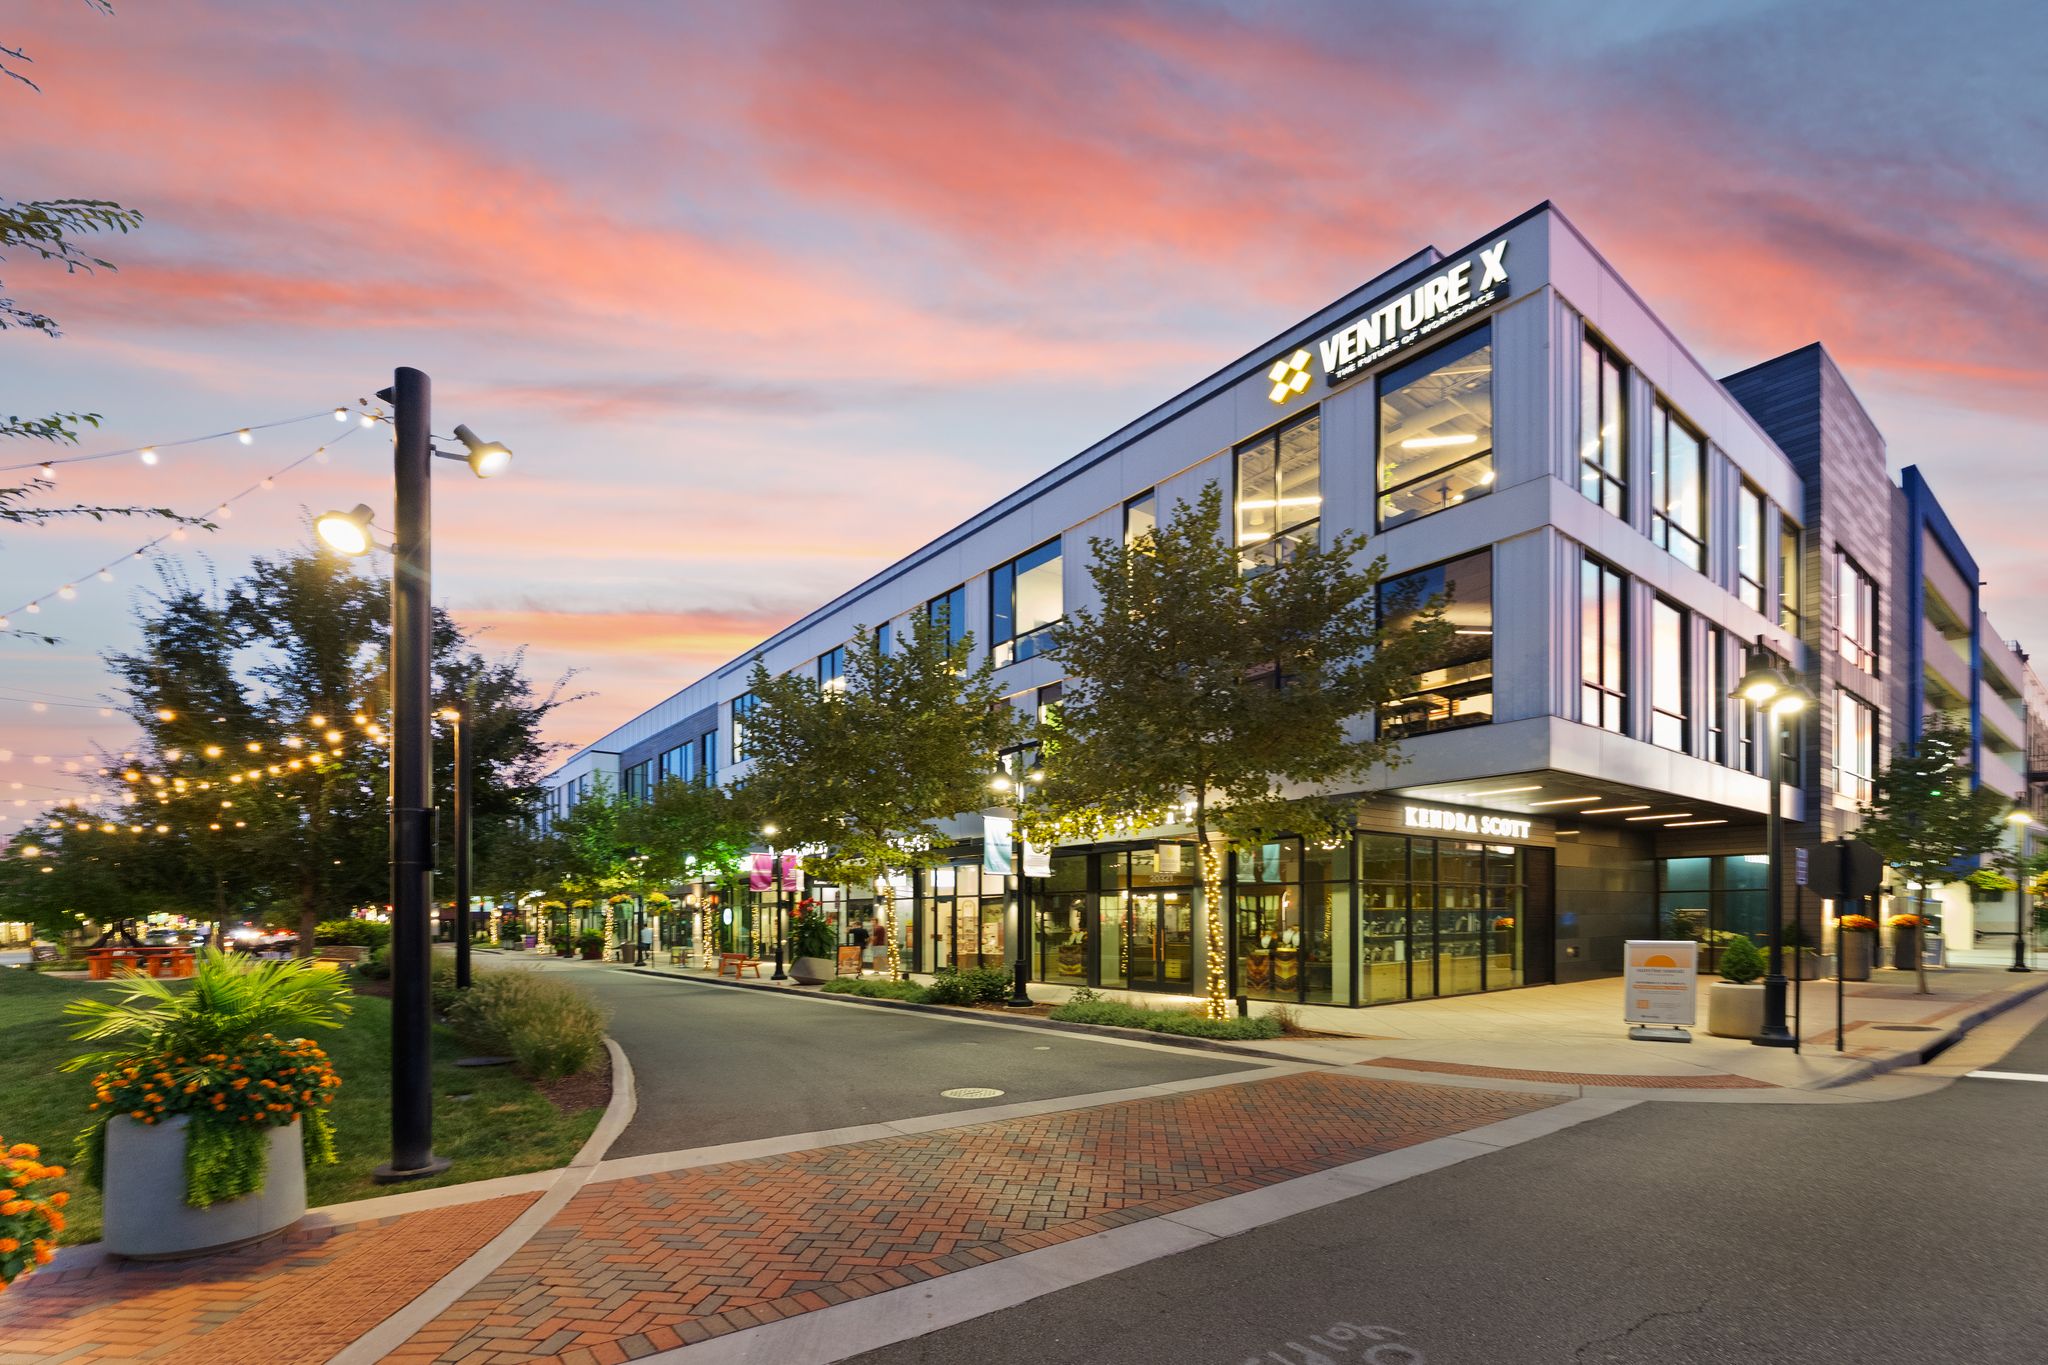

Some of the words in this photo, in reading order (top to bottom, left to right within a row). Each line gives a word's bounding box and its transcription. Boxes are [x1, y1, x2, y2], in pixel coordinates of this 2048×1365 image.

[1319, 260, 1472, 373] VENTURE
[1480, 240, 1508, 291] X
[1336, 365, 1356, 378] THE
[1358, 341, 1399, 367] FUTURE
[1401, 331, 1418, 345] OF
[1420, 291, 1496, 334] WORKSPACE
[1405, 806, 1478, 833] KENDRA
[1481, 816, 1531, 838] SCOTT
